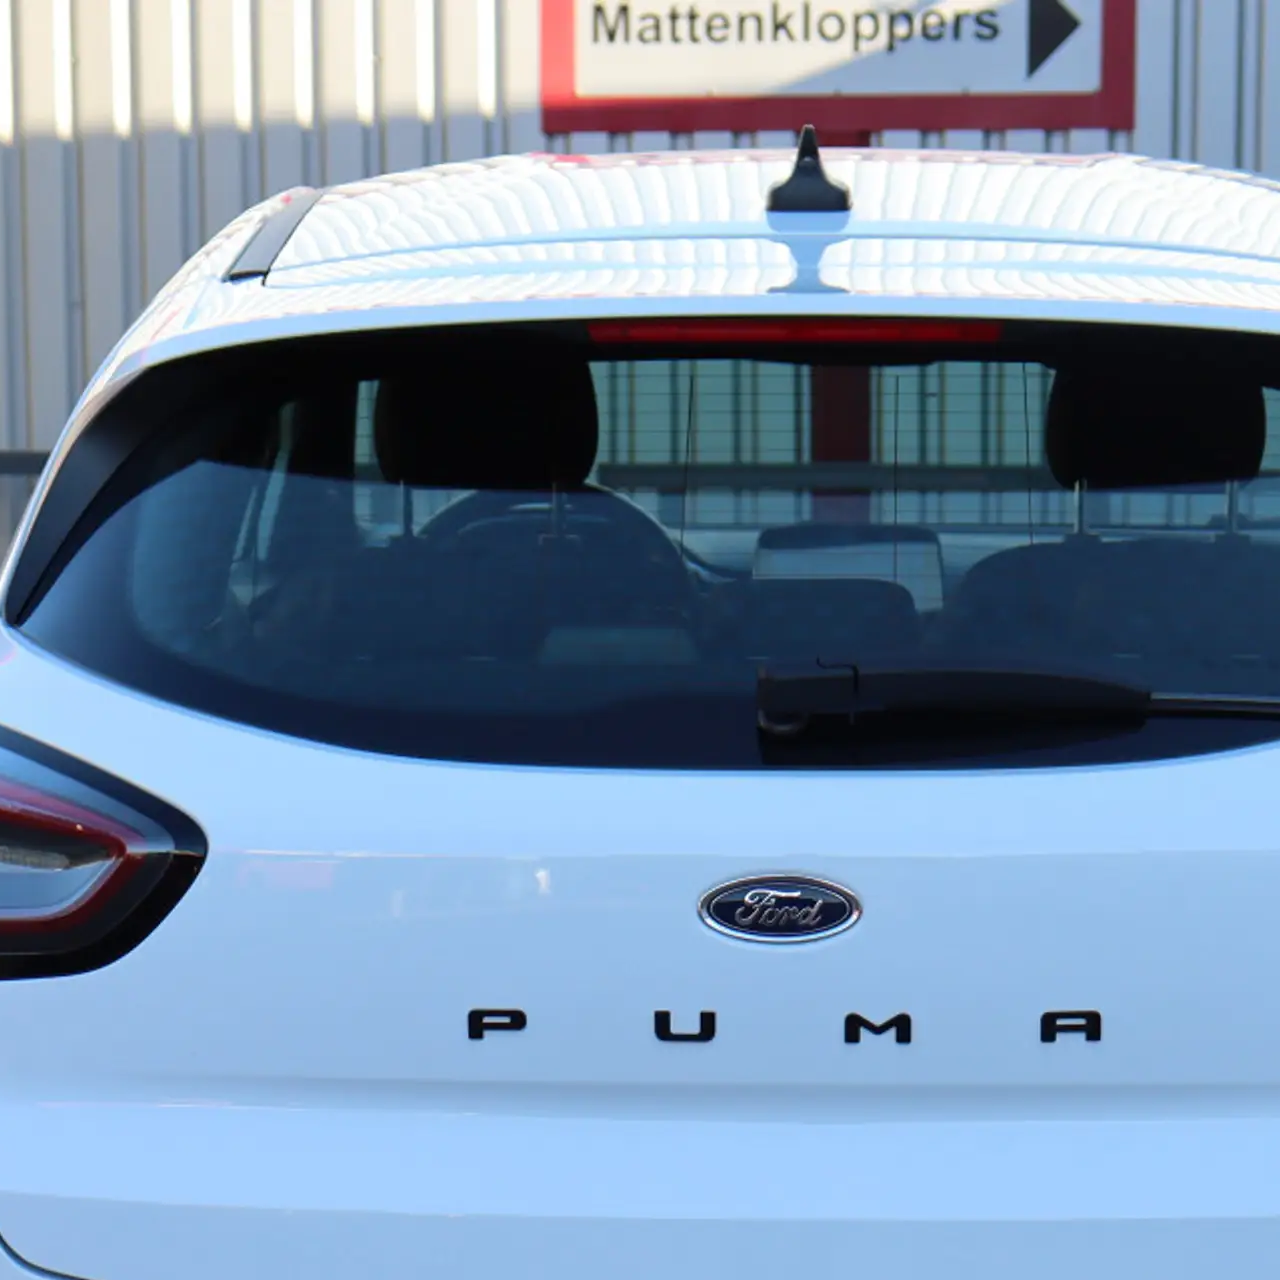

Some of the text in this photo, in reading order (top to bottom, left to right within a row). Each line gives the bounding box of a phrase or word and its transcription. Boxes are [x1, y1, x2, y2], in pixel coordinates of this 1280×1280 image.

[591, 0, 1000, 52] Mattenkloppers
[734, 888, 823, 927] Ford
[468, 1008, 1102, 1044] PUMA
